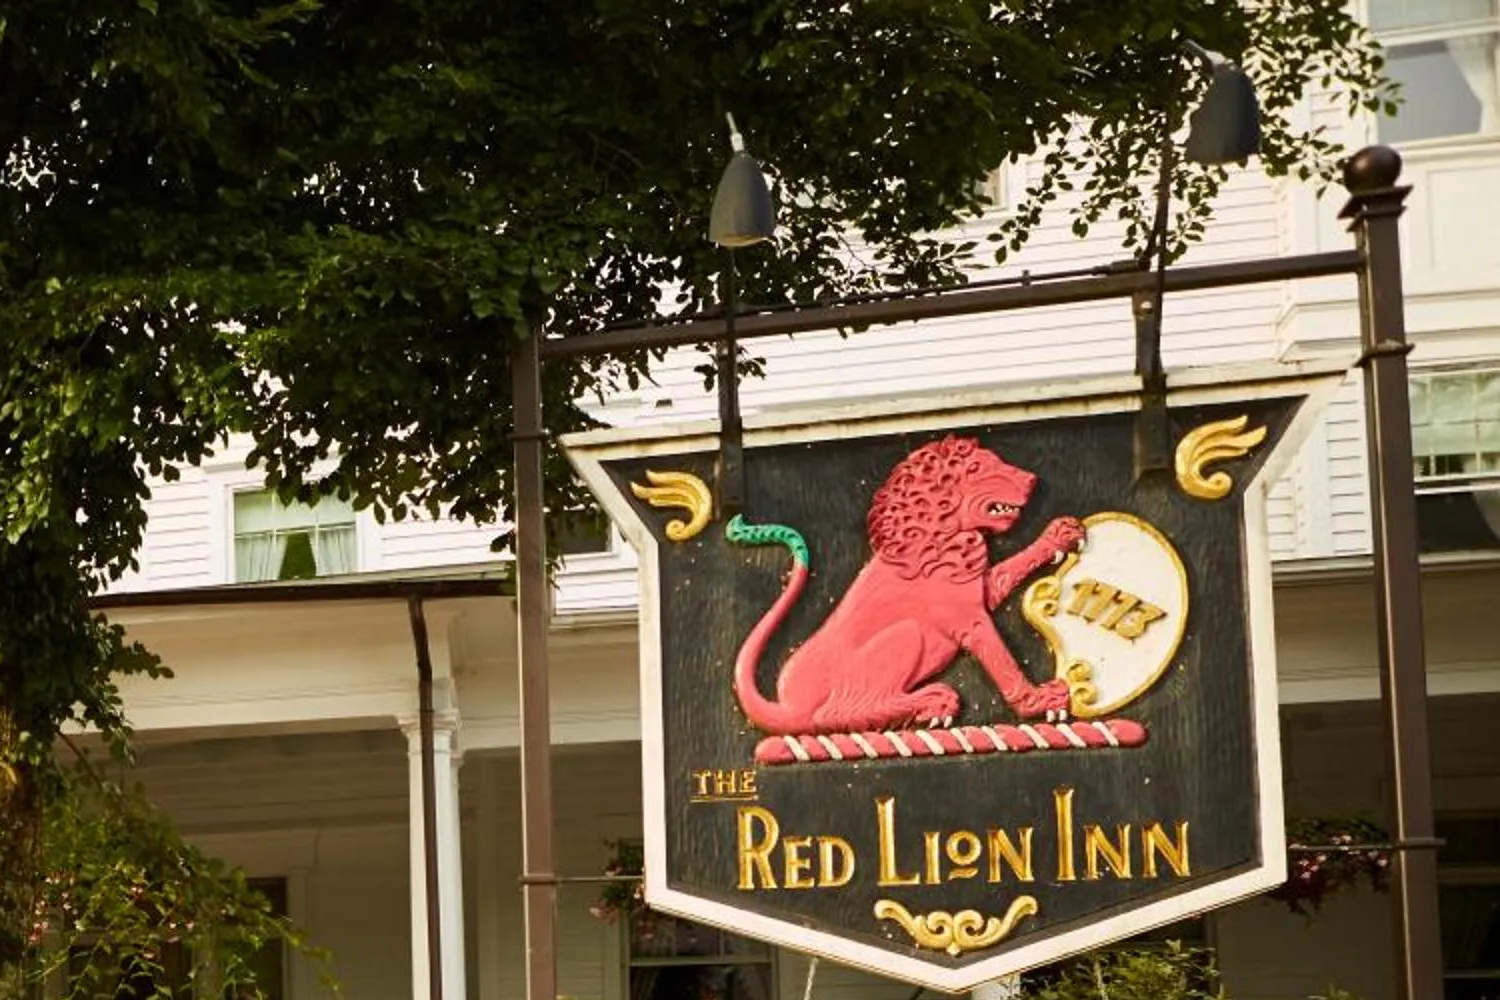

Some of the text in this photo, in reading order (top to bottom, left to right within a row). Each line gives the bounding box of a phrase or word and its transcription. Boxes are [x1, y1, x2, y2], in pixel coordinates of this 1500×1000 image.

[1067, 580, 1168, 641] 1773
[693, 769, 758, 796] THE
[737, 785, 1192, 890] RED LION INN
